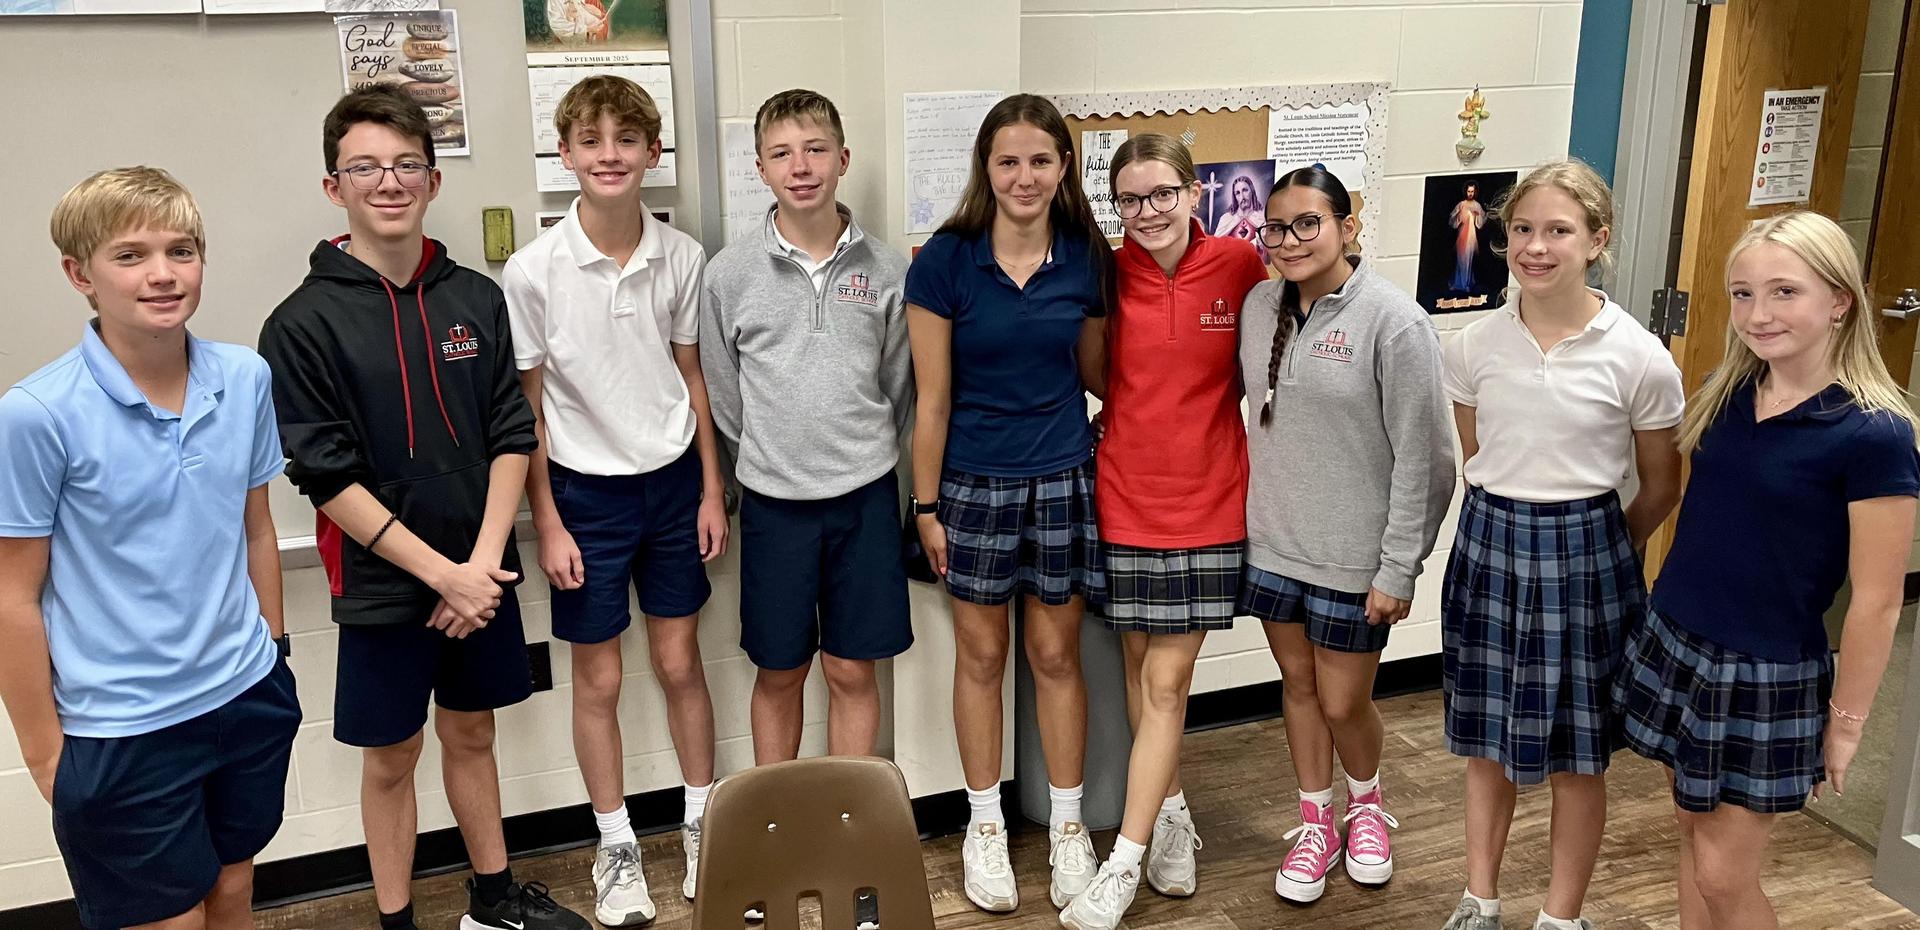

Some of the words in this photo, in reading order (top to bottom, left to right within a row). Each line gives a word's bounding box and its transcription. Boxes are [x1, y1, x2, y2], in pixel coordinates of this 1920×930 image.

[413, 24, 442, 32] UNIQUE
[346, 22, 394, 52] God
[411, 43, 441, 51] SPECIAL
[350, 55, 395, 78] says
[1768, 98, 1775, 106] IN
[1775, 97, 1784, 106] AN
[1785, 96, 1820, 105] EMERGENCY
[1099, 133, 1111, 149] THE
[1085, 154, 1110, 178] futu
[838, 287, 850, 296] ST.
[853, 289, 878, 300] LOUIS
[1200, 316, 1212, 324] ST.
[1214, 316, 1234, 324] LOUIS
[442, 344, 456, 353] ST.
[456, 341, 478, 352] LOUIS
[1325, 345, 1353, 356] LOUIS
